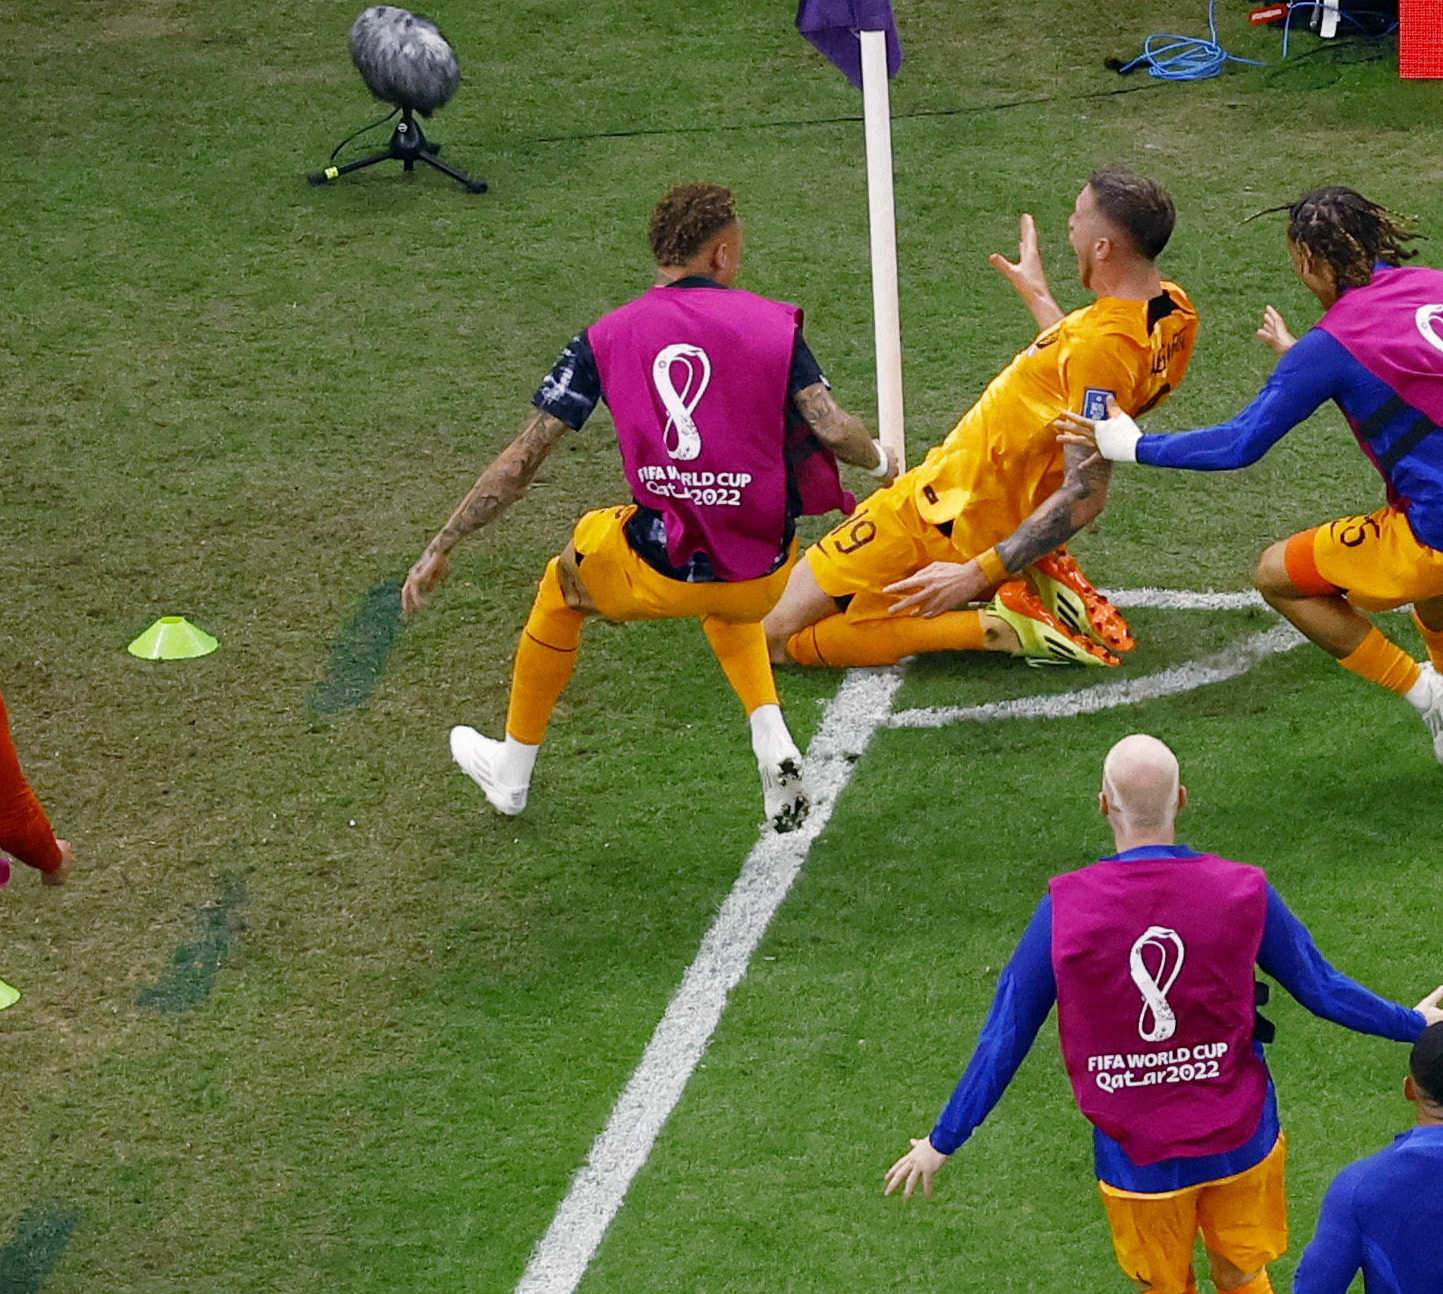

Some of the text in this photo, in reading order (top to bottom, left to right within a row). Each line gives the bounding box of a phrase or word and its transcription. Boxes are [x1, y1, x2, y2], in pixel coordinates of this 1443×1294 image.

[638, 466, 752, 488] FIFA WRLD CUP
[1088, 1042, 1228, 1073] FIFA WORLD CUP
[1095, 1060, 1221, 1094] Qatar2022
